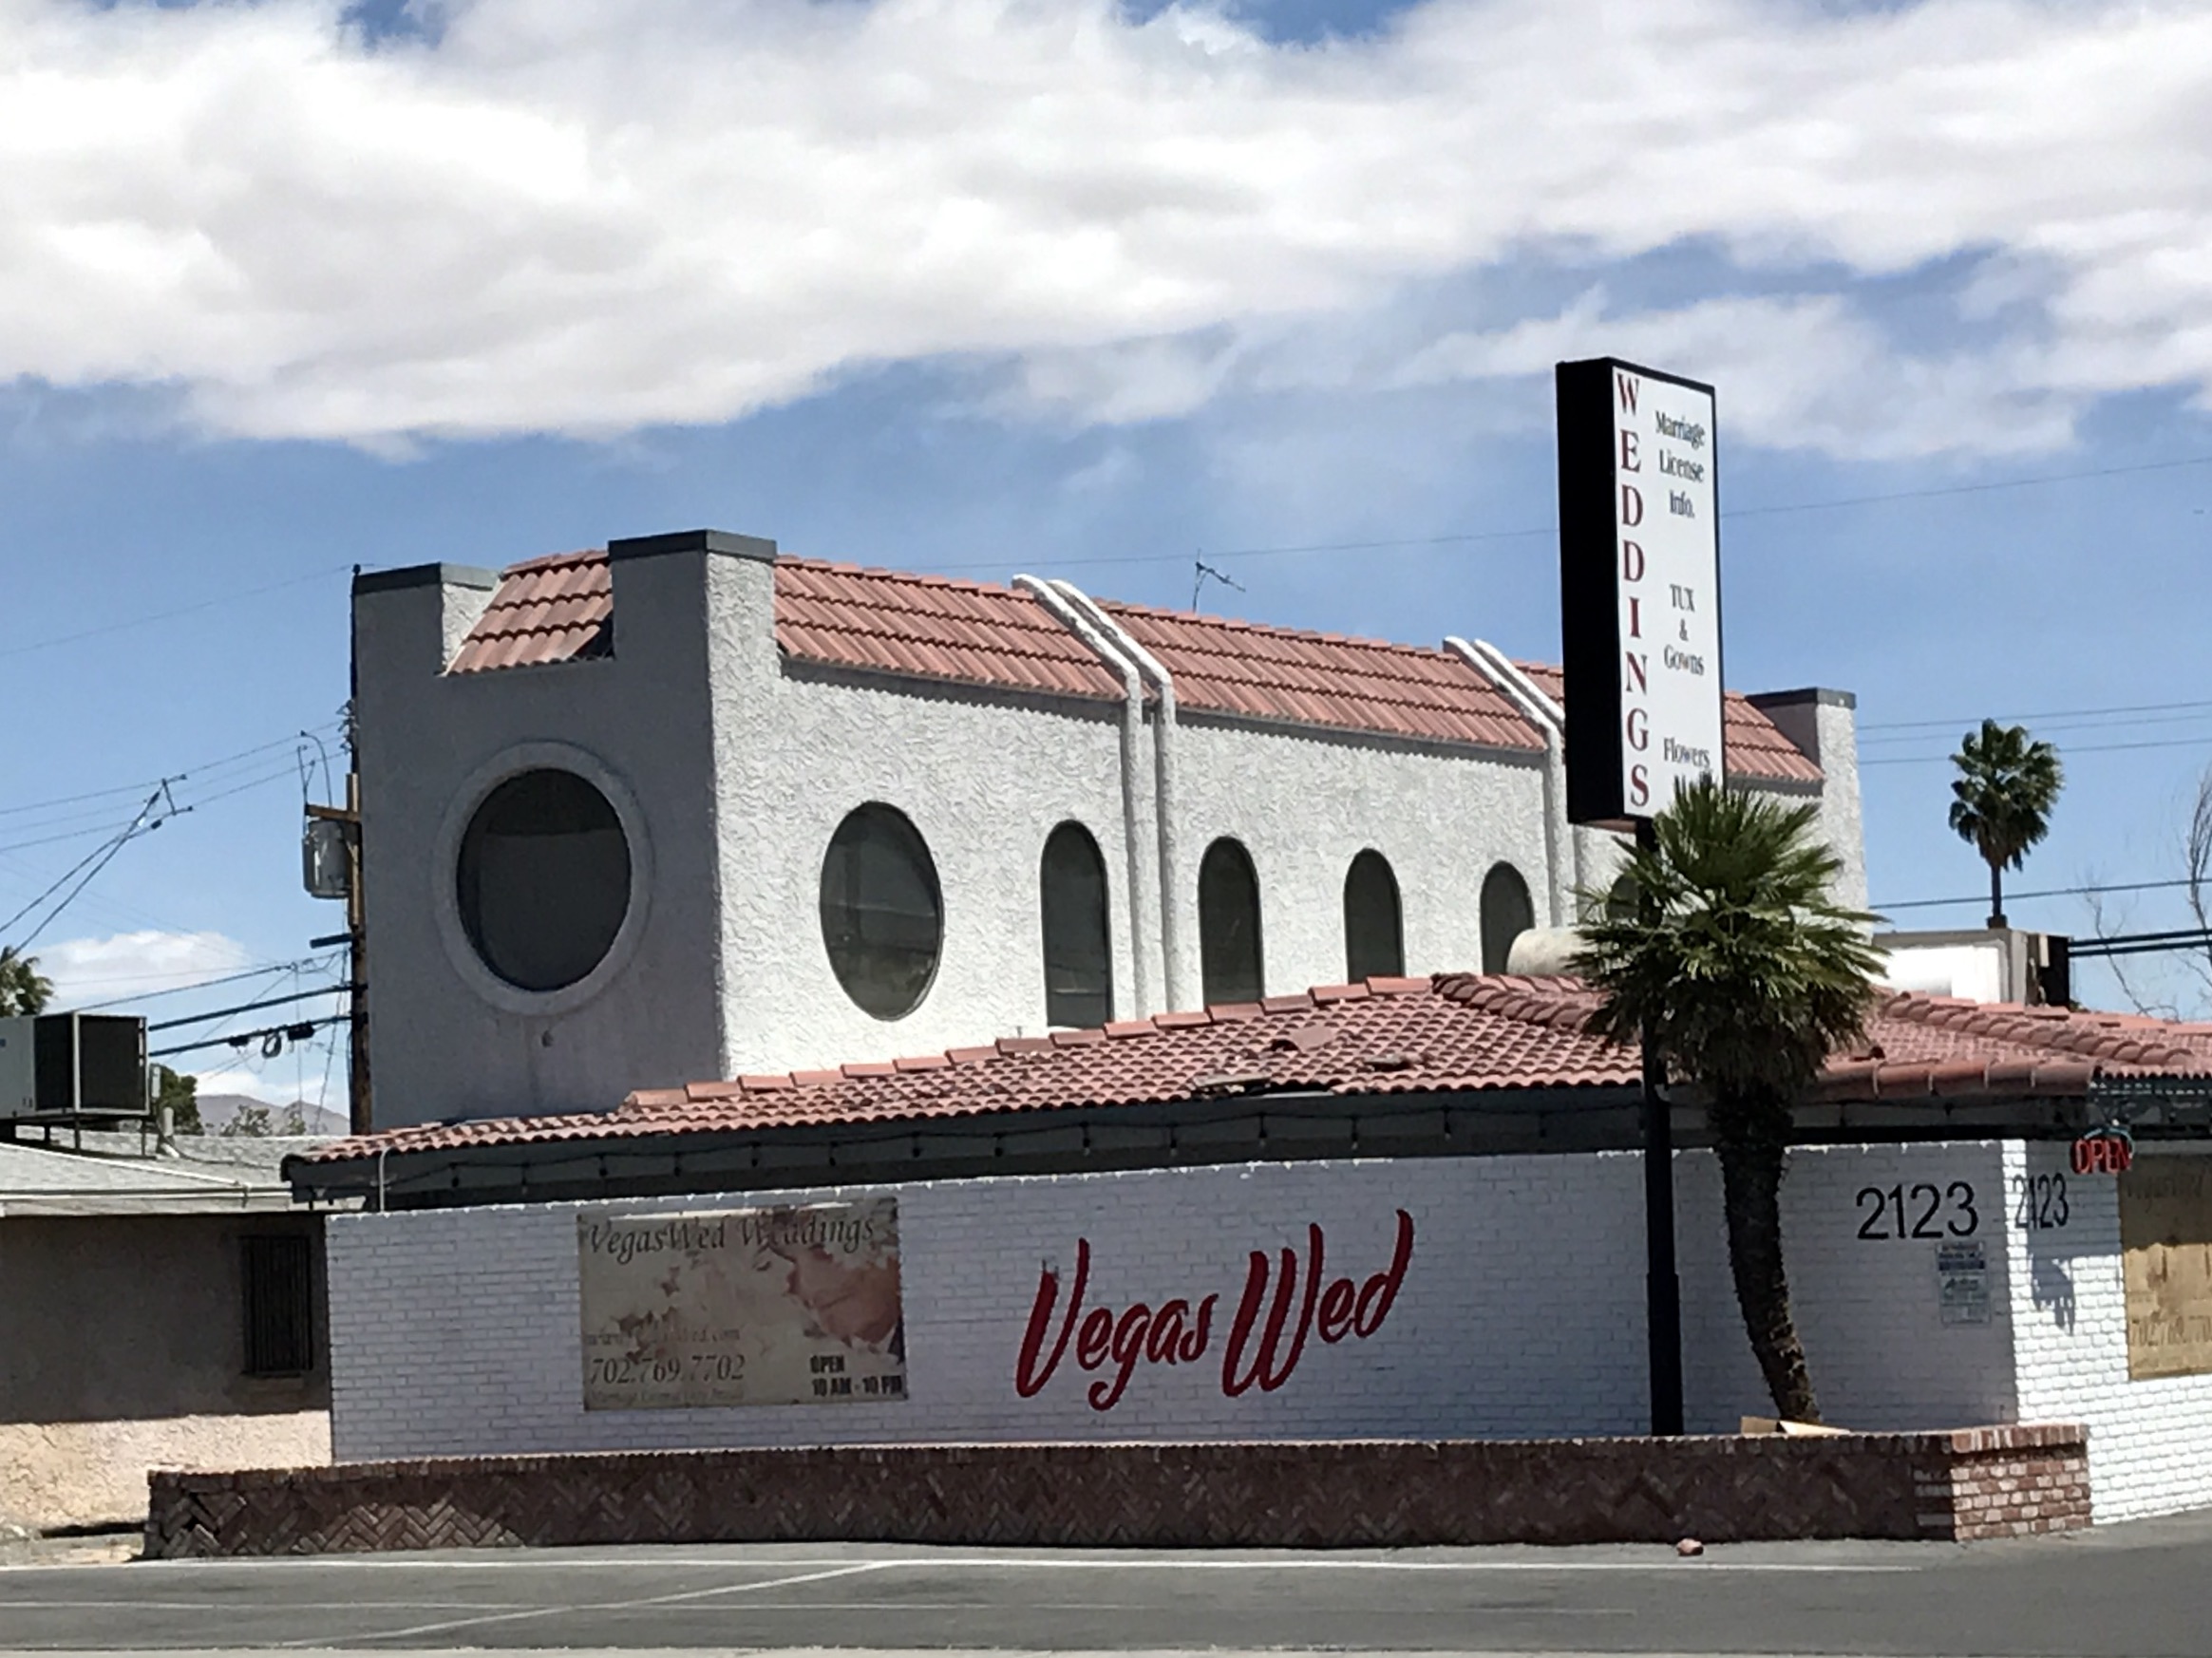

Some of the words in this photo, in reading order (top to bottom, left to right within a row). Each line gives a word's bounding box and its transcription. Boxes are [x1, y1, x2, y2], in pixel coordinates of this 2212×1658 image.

[1655, 409, 1706, 449] Marriage
[1658, 448, 1705, 483] License
[1669, 489, 1695, 518] Info.
[1616, 372, 1650, 807] WEDDINGS
[1670, 583, 1695, 612] TUX
[1679, 618, 1689, 642] &
[1663, 644, 1705, 676] Gowns
[1663, 737, 1711, 768] Flowers
[2074, 1140, 2130, 1174] OPEN
[1856, 1181, 1979, 1240] 2123
[2013, 1173, 2070, 1231] 2123
[1015, 1237, 1219, 1411] Vegas
[1221, 1209, 1415, 1397] Wed
[589, 1353, 747, 1385] 702.769.7702
[810, 1355, 844, 1374] OPEN
[813, 1379, 826, 1397] 10
[830, 1378, 852, 1395] AM
[862, 1377, 878, 1395] 10
[882, 1375, 902, 1394] PM
